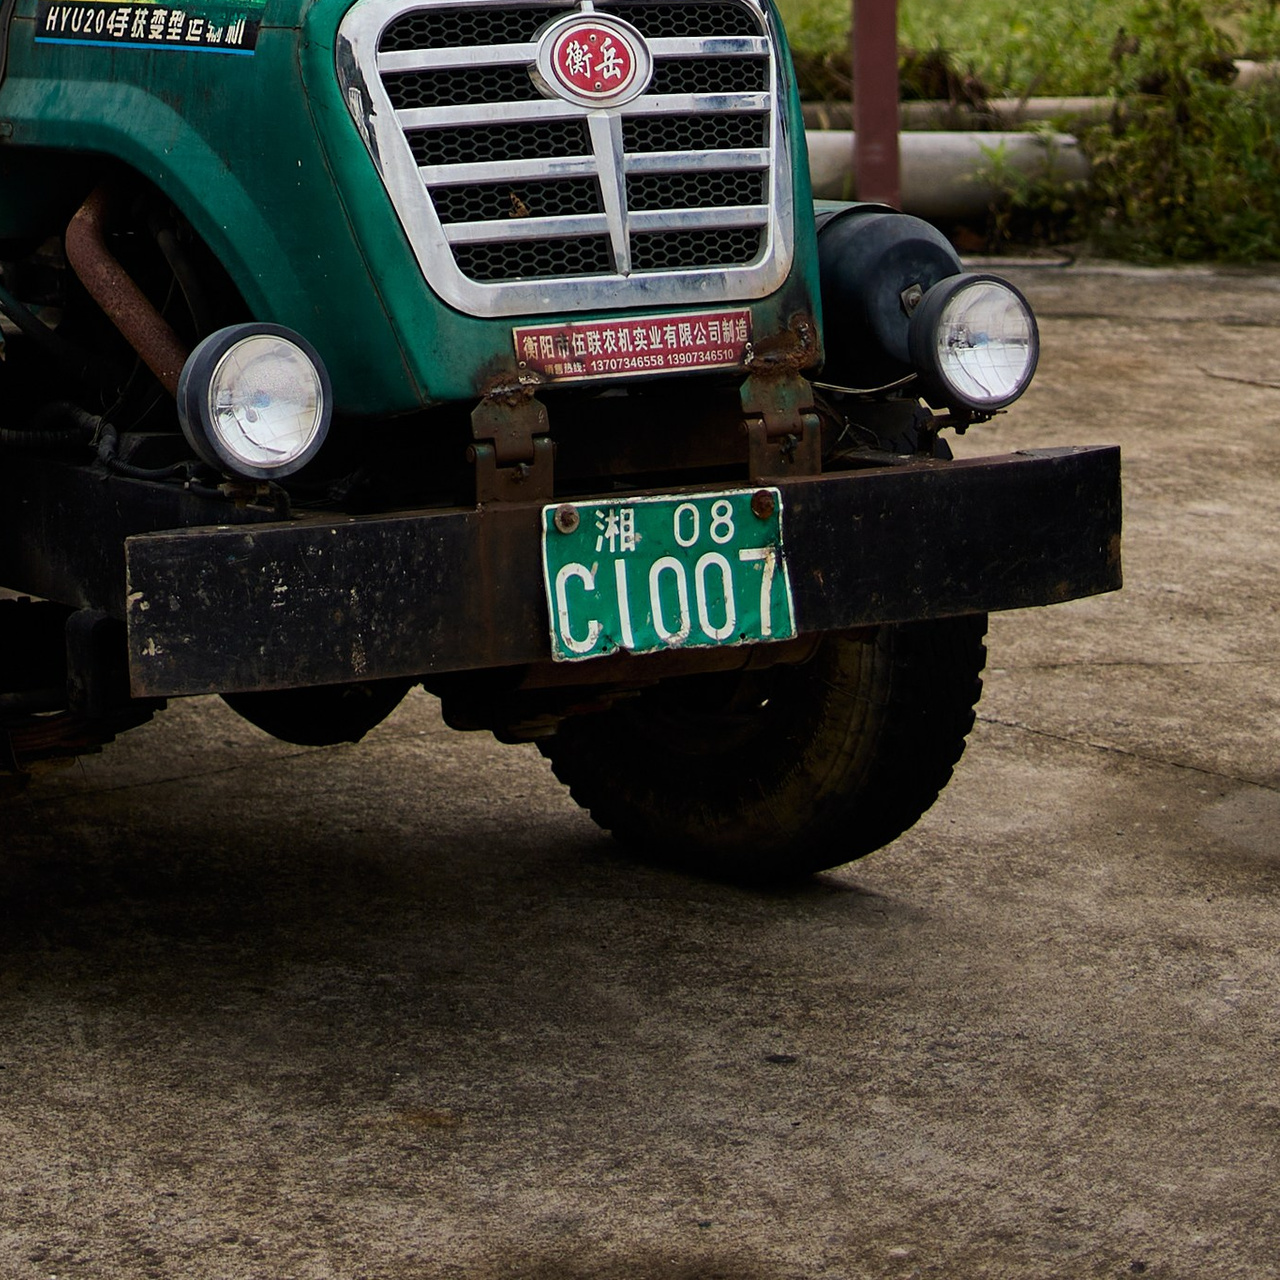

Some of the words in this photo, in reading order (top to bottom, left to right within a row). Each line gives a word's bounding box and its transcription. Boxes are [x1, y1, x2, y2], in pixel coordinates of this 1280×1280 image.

[565, 37, 624, 80] 衡岳
[523, 318, 749, 361] 衡阳市伍联农机实业有限公司制造
[591, 353, 664, 372] 13707346558
[595, 508, 636, 553] 湘
[673, 499, 735, 548] 08
[555, 546, 776, 654] C1007
